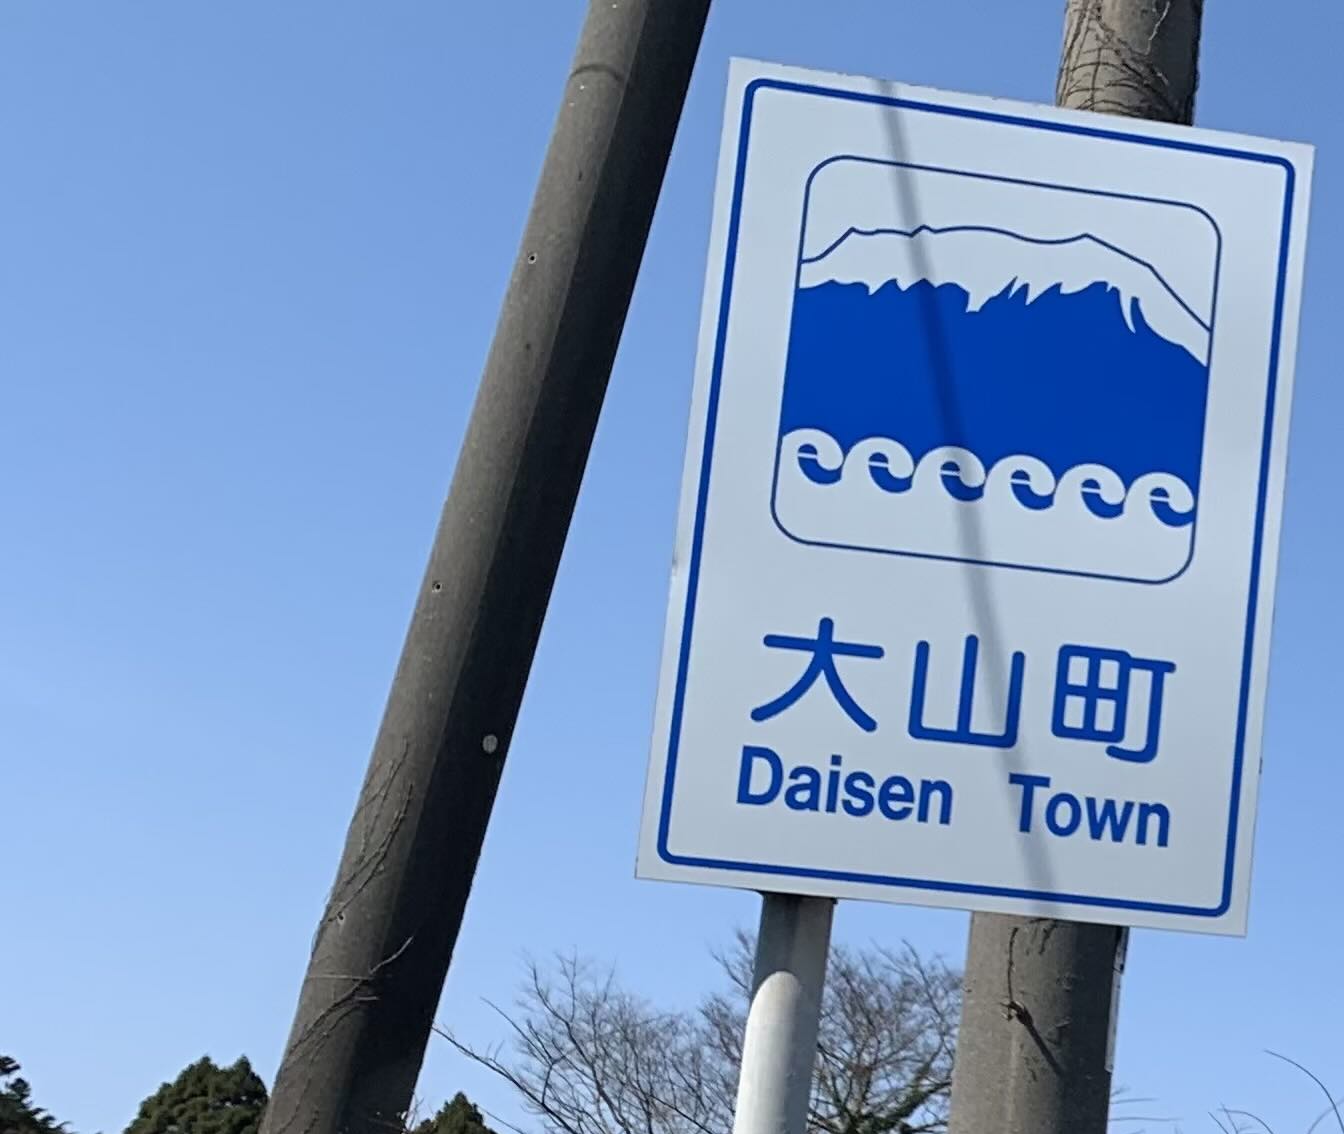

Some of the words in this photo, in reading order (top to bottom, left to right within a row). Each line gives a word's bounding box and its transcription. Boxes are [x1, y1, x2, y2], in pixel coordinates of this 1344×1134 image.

[750, 617, 1176, 763] 大山町
[736, 745, 953, 825] Daisen
[1008, 772, 1171, 847] Town
